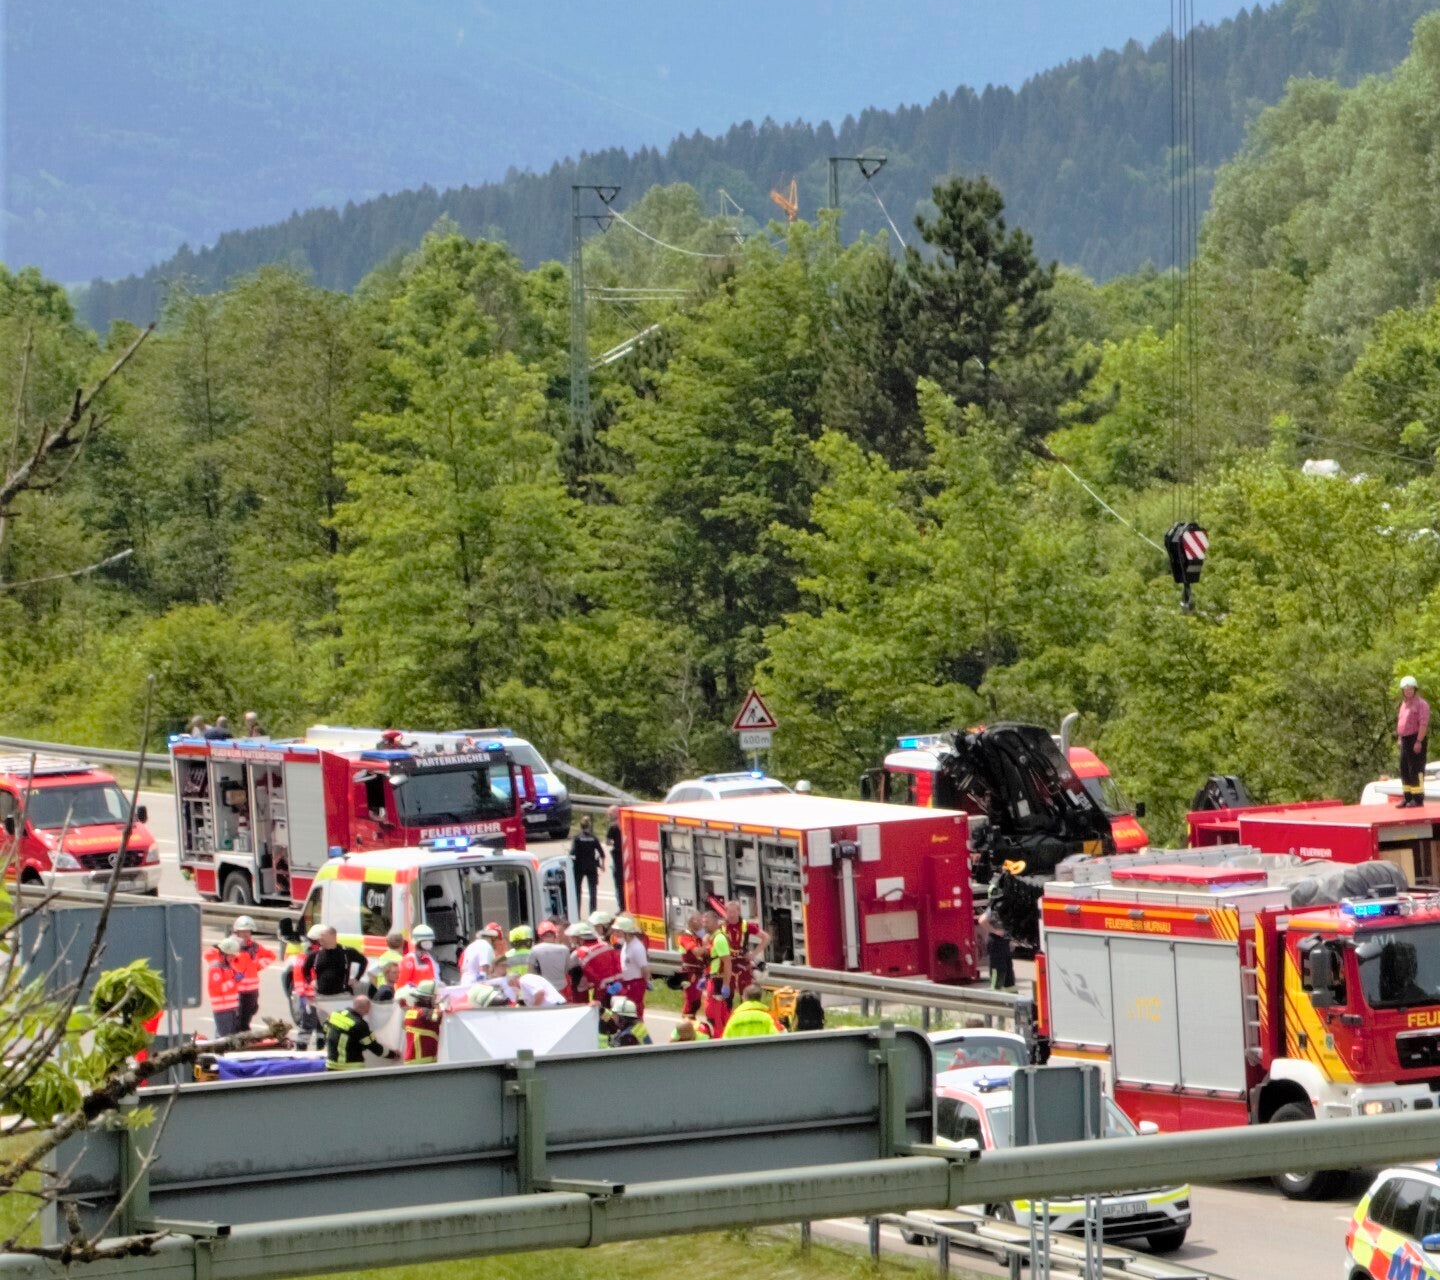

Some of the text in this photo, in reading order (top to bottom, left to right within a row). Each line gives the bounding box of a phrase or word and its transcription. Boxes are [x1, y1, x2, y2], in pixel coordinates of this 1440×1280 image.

[415, 751, 491, 768] PARTENKIRCHEN
[1299, 847, 1333, 858] FEUERWEHR
[1105, 917, 1171, 933] FEUERWEHR MURNAU
[1136, 995, 1161, 1021] 112
